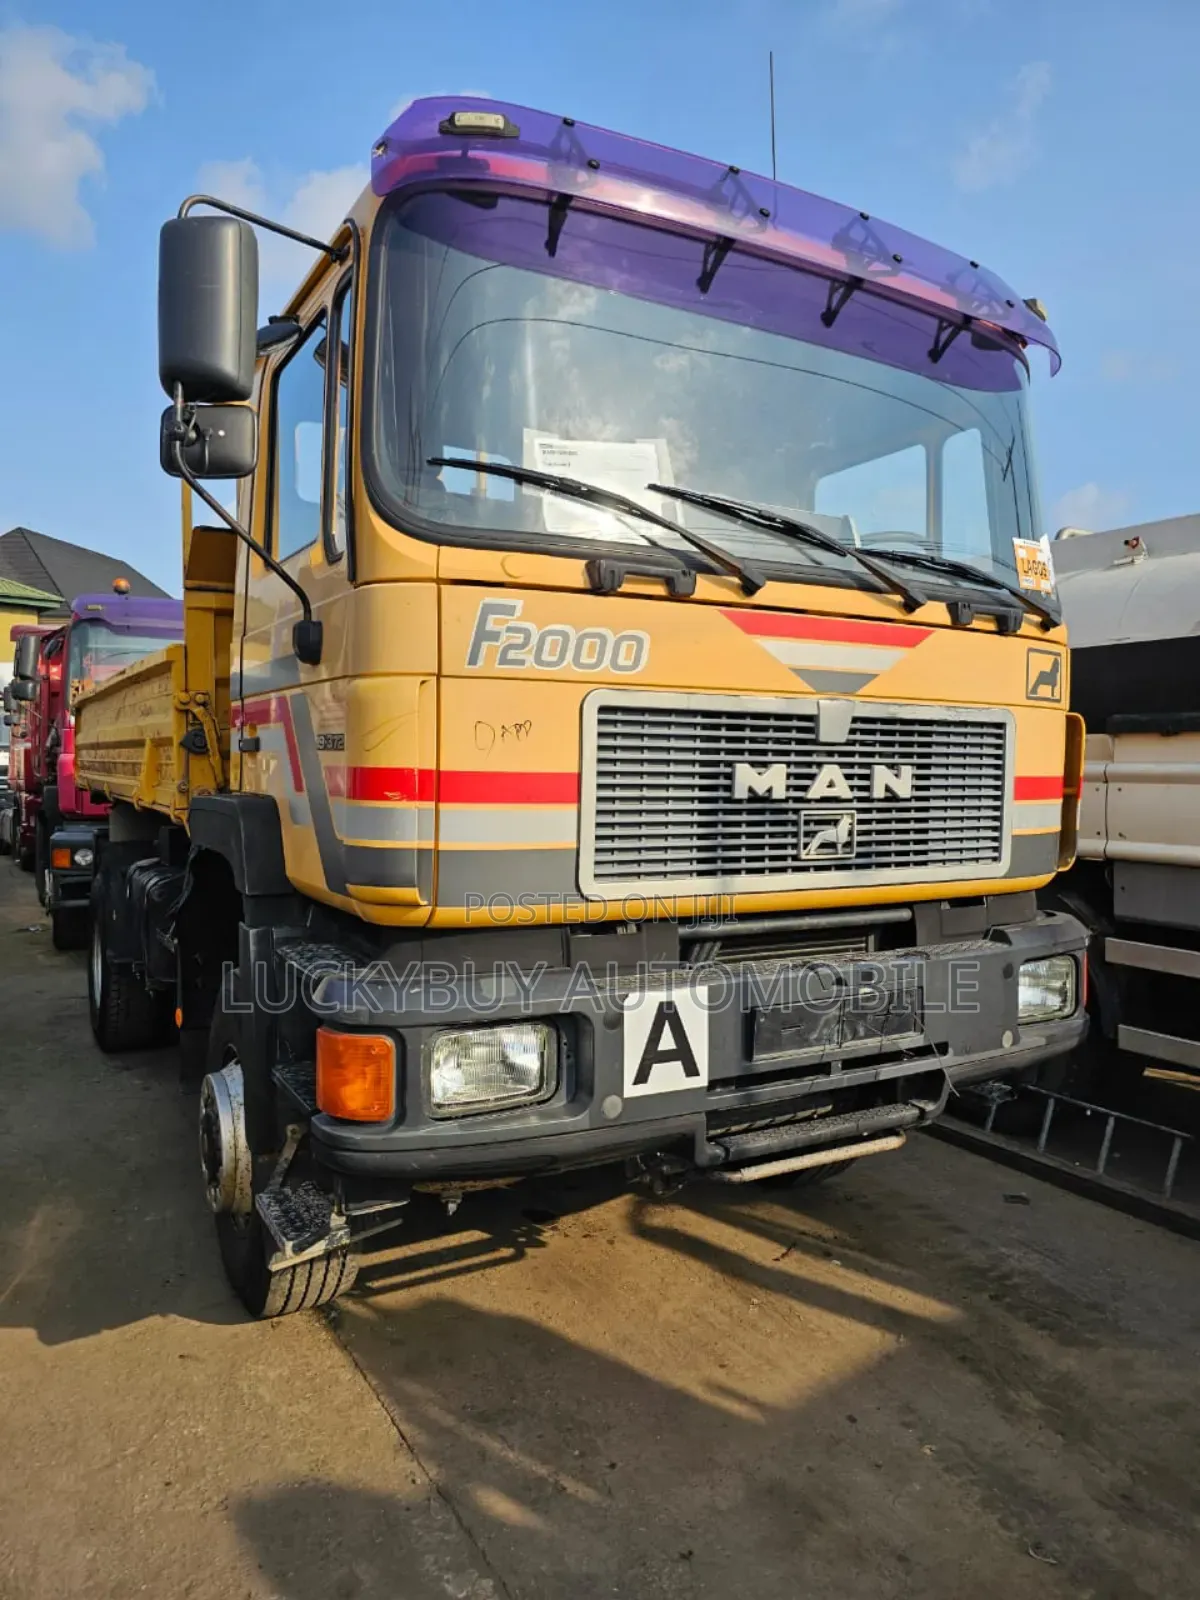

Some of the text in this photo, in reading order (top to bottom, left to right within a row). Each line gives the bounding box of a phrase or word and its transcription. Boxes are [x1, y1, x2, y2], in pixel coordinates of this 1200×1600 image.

[465, 597, 650, 674] F2000
[732, 763, 913, 800] MAN
[632, 1000, 701, 1086] A
